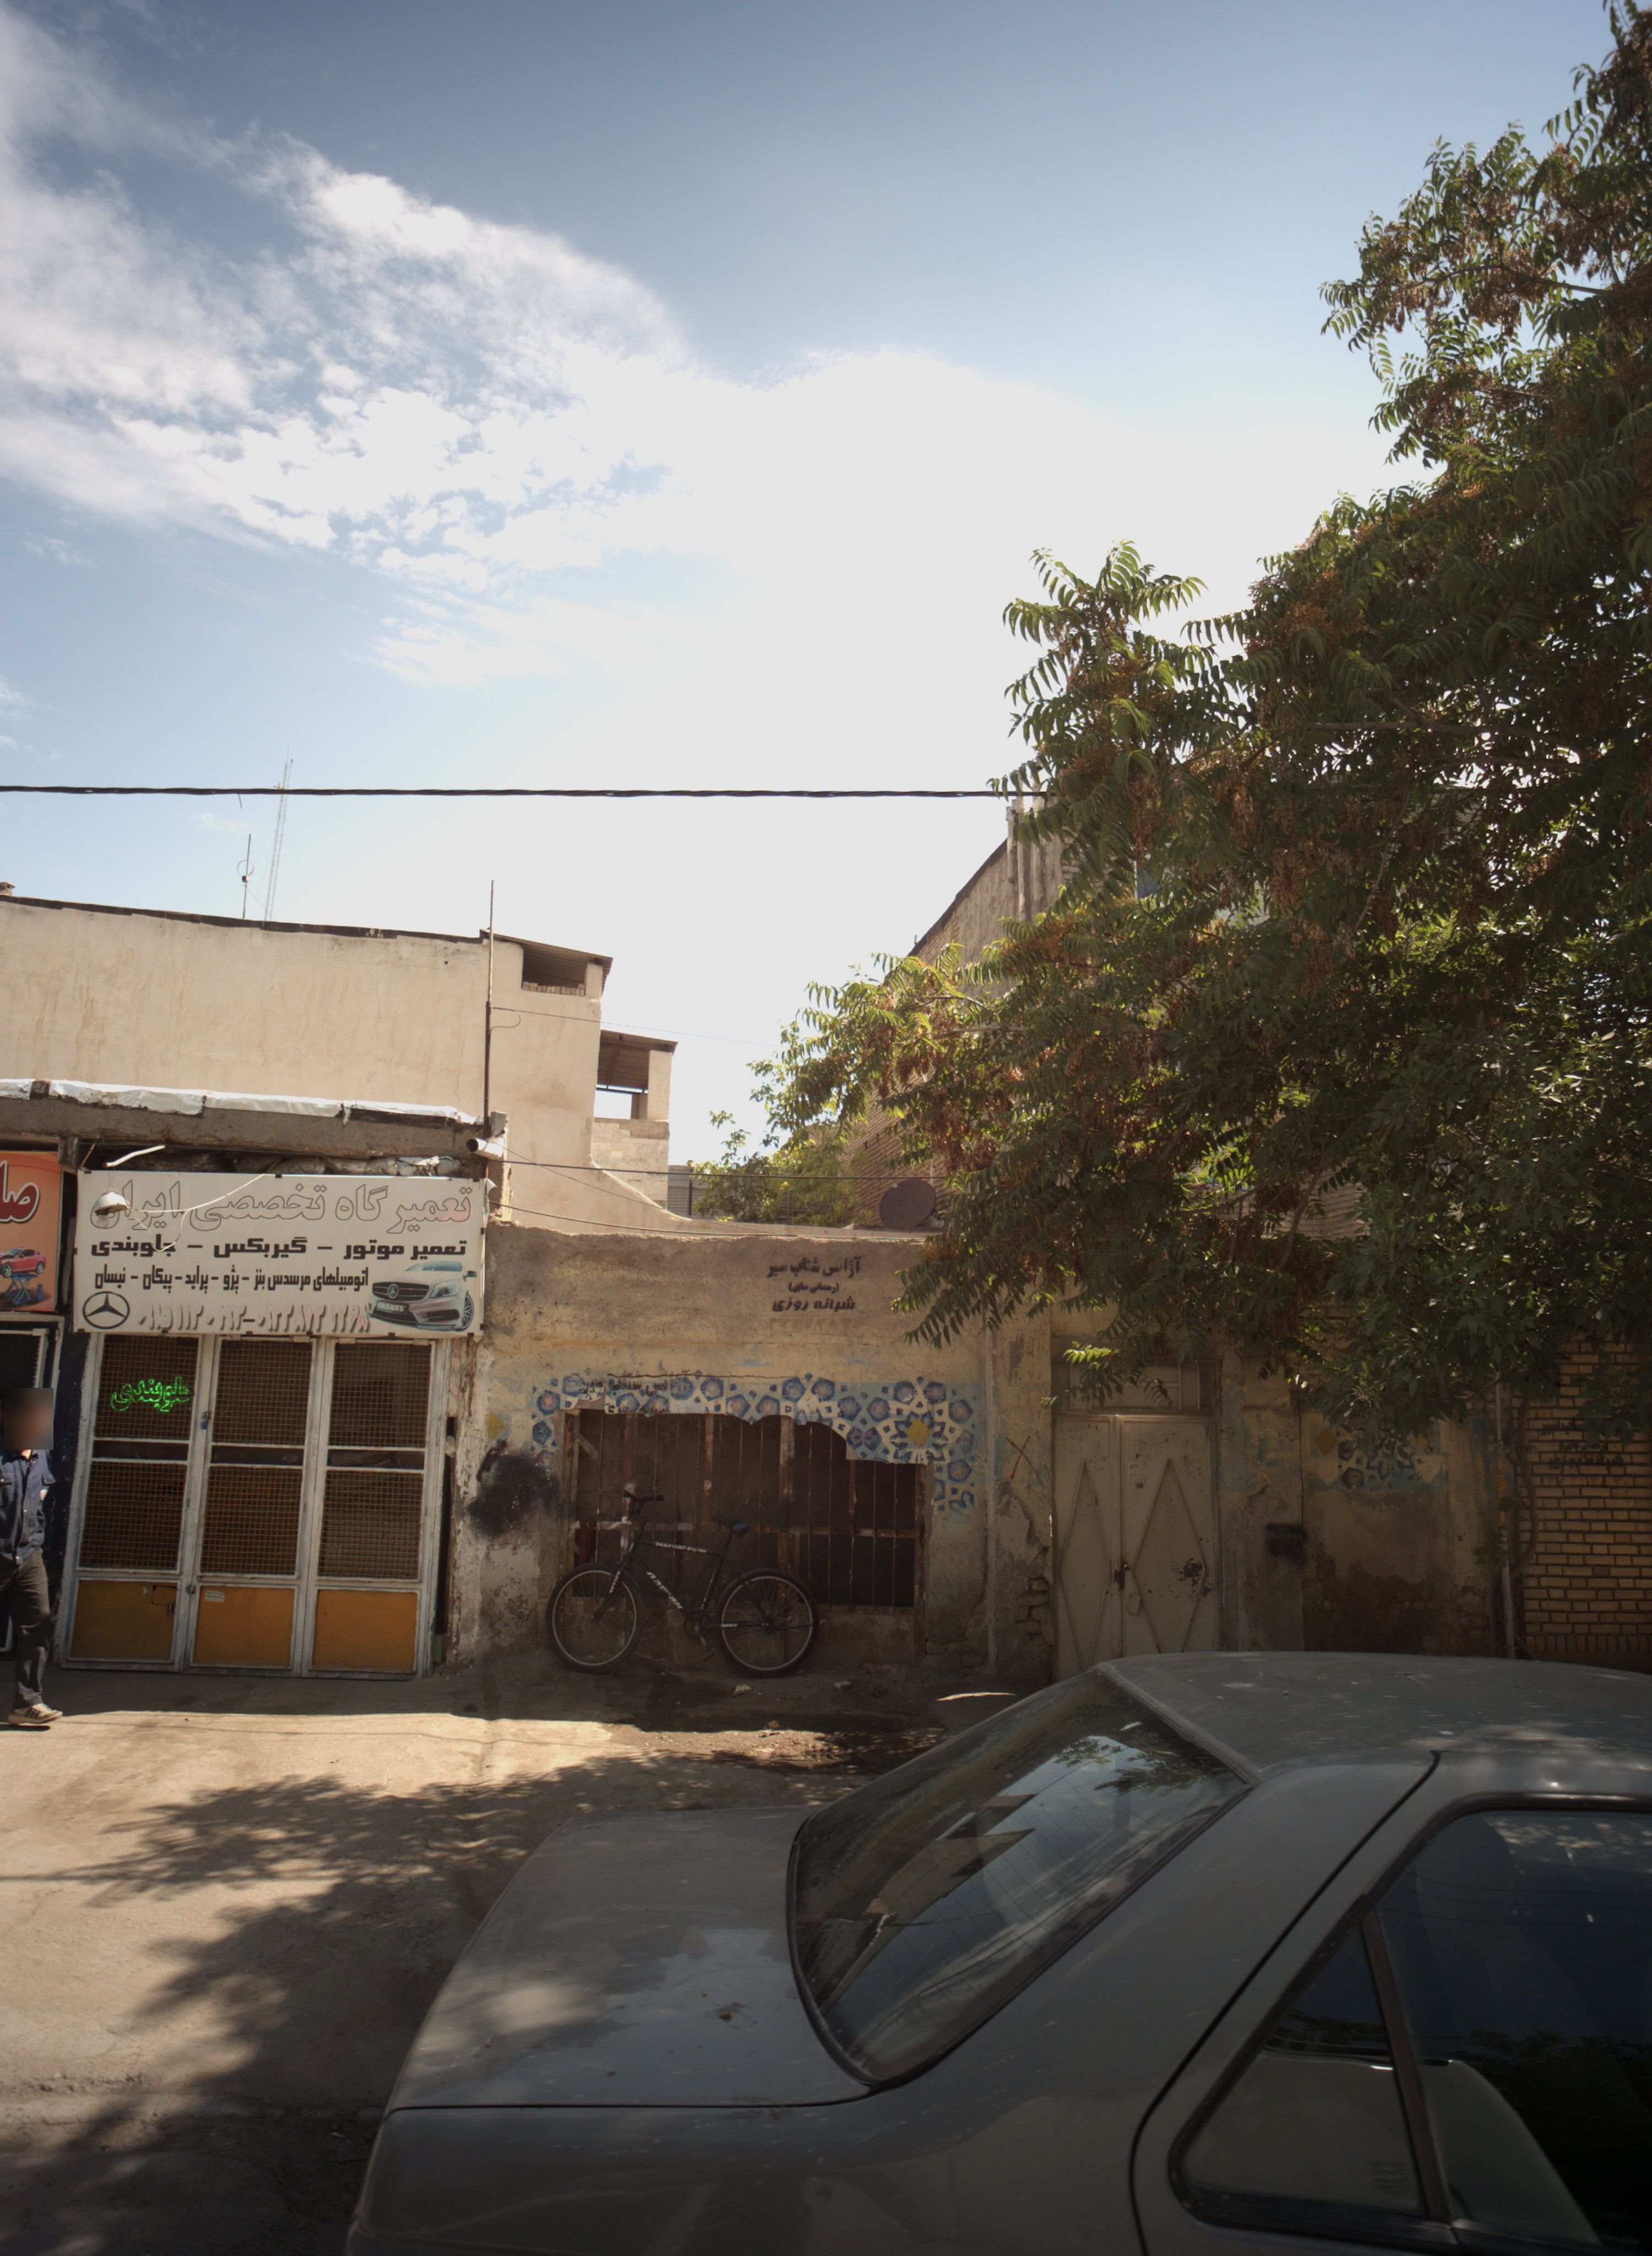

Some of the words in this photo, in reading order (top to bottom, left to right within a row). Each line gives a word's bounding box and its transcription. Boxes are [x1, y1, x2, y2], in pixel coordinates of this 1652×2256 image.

[190, 1183, 327, 1232] تخصصی
[91, 1234, 176, 1258] جلوبندی
[214, 1237, 308, 1259] گیربکس
[343, 1239, 405, 1260] موتور
[410, 1240, 468, 1261] تعمیر
[95, 1264, 126, 1289] نیسان
[143, 1265, 173, 1294] پیکان
[184, 1265, 209, 1294] پراید
[222, 1265, 240, 1294] پژو
[254, 1268, 265, 1291] بنز
[268, 1275, 311, 1292] مرسدس
[313, 1267, 369, 1292] اتومبیلهای
[772, 1297, 809, 1312] روزی
[813, 1296, 856, 1313] شبانه
